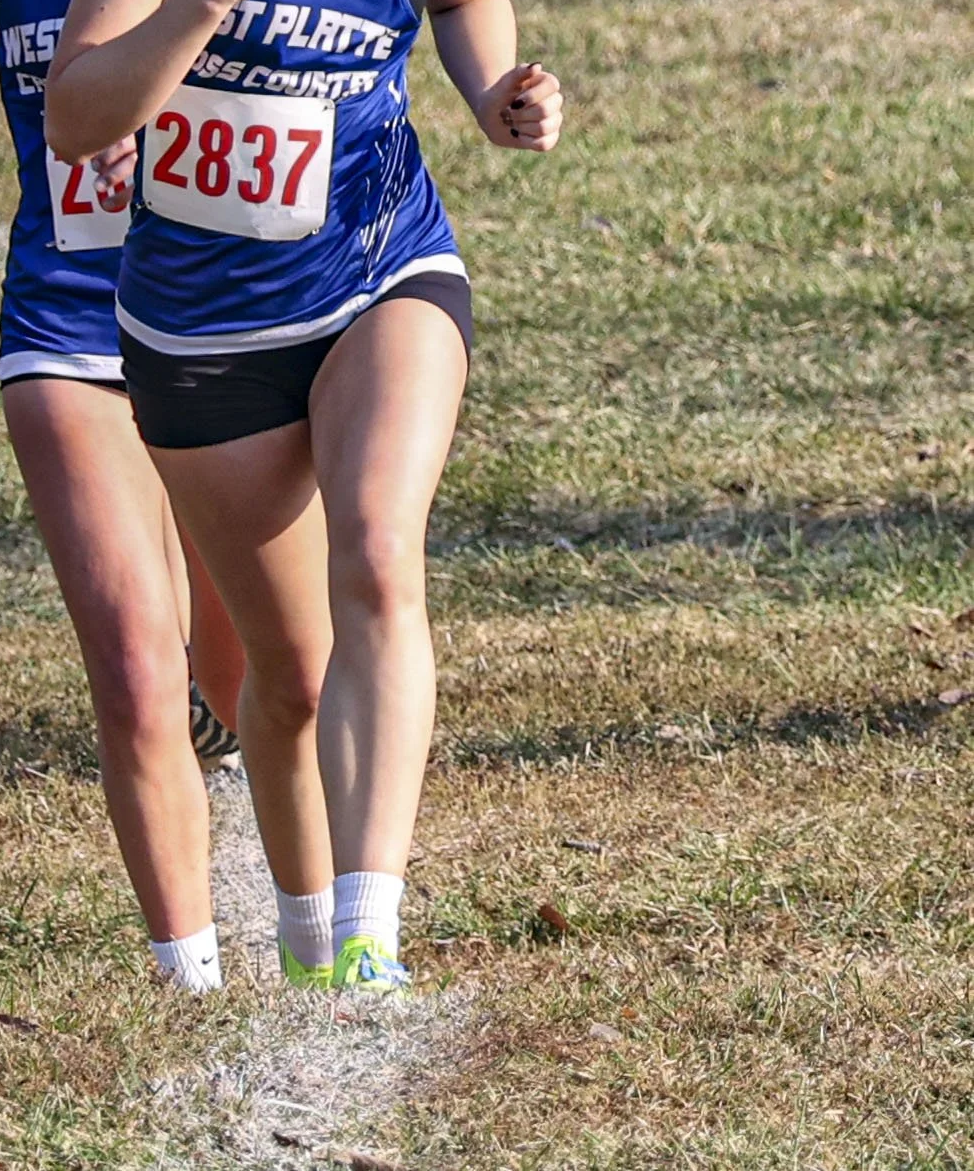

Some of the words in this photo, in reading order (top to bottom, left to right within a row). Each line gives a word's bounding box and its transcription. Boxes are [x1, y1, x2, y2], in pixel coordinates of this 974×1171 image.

[262, 3, 400, 60] PLATTE
[242, 65, 379, 99] COUNTR
[152, 111, 323, 207] 2837
